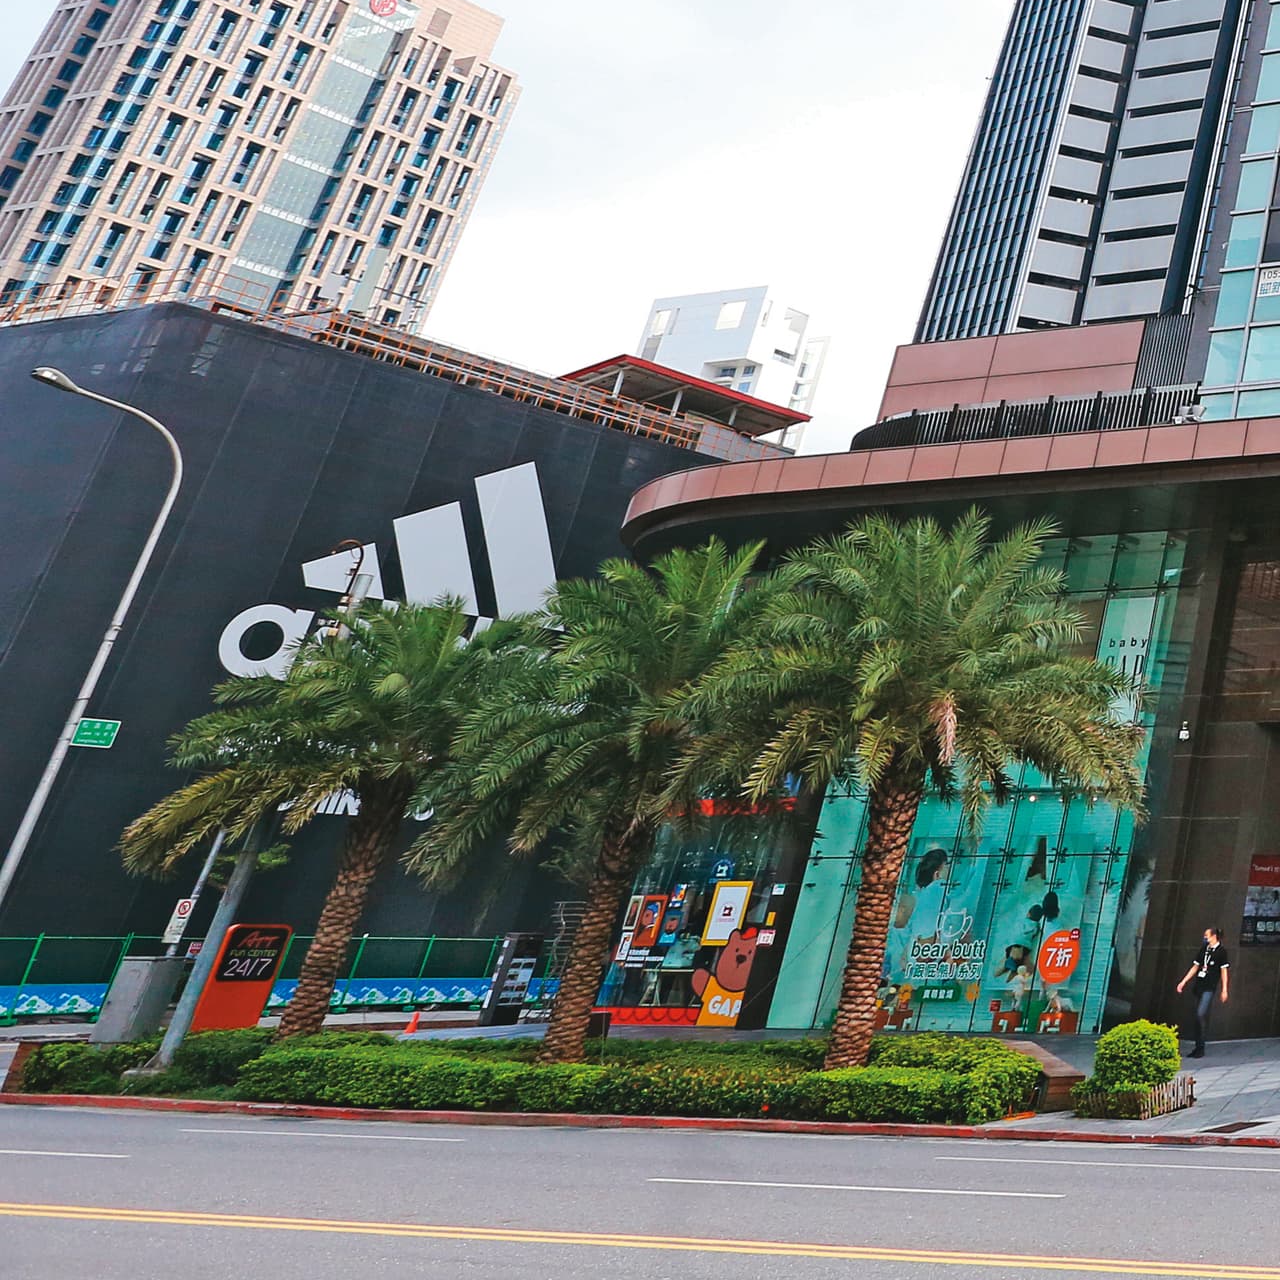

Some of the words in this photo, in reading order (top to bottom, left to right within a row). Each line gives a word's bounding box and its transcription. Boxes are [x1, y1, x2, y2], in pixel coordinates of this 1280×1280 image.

[1109, 637, 1147, 648] baby
[911, 939, 948, 959] bear
[951, 939, 986, 959] butt
[1045, 947, 1073, 968] 7折
[223, 958, 272, 977] 24/7
